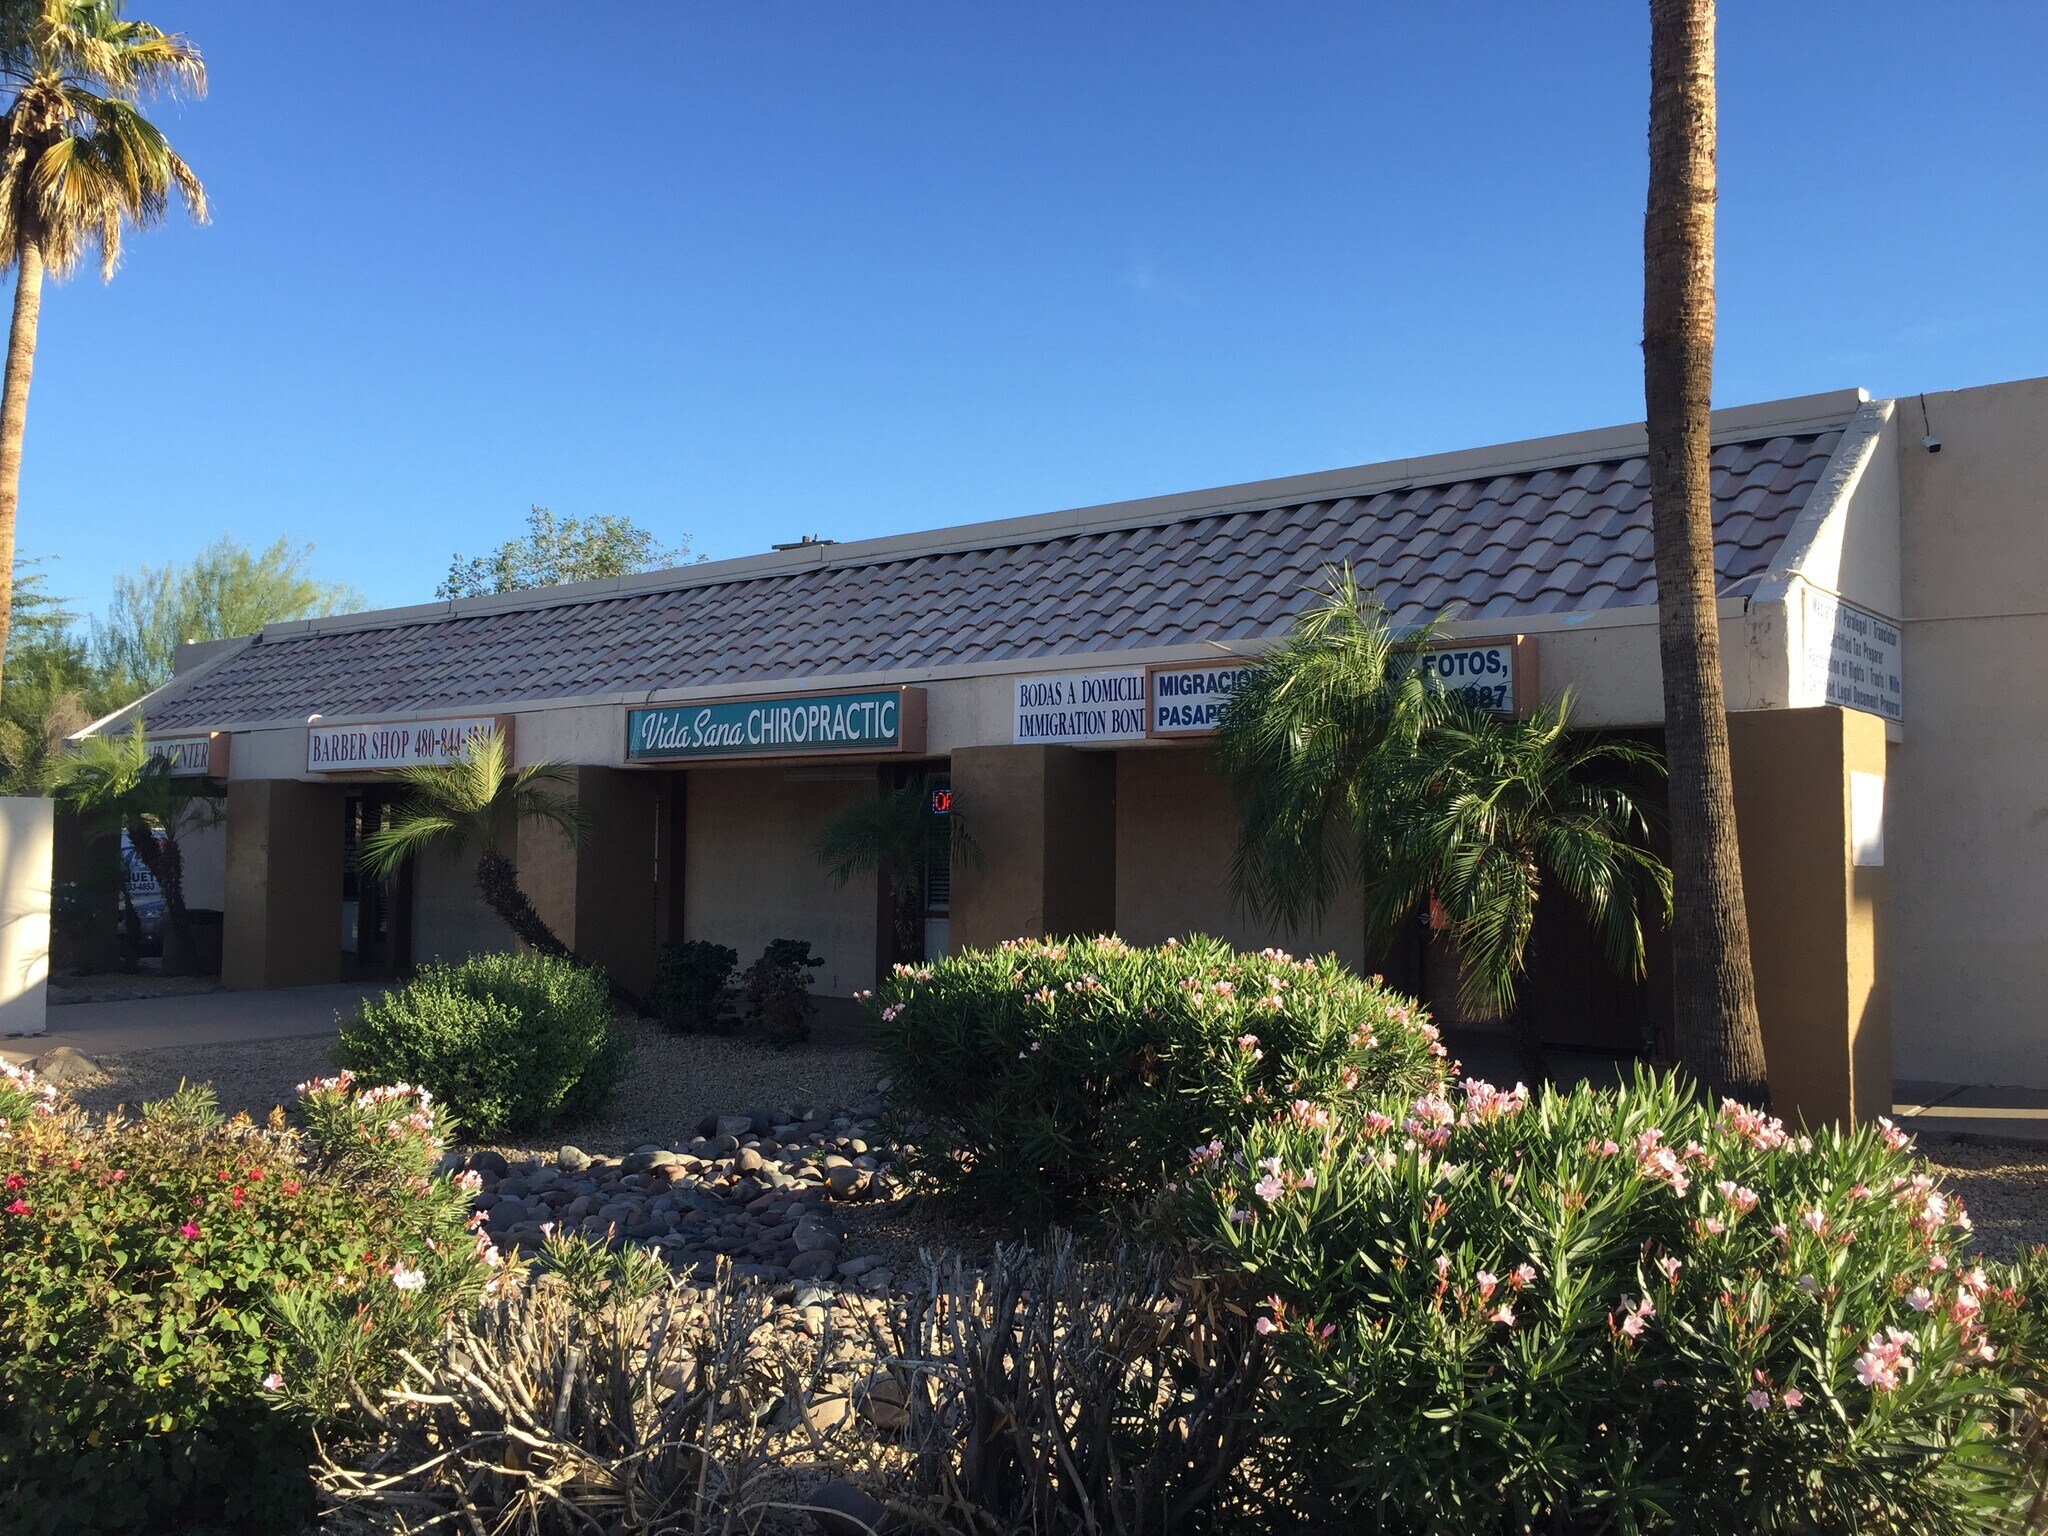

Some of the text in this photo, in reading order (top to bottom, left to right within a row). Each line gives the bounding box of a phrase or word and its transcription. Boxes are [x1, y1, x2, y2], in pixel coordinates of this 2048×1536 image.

[1842, 608, 1868, 637] Paralegal
[1852, 637, 1861, 657] Tax
[1020, 681, 1062, 707] BODAS
[1067, 681, 1077, 705] A
[1159, 670, 1254, 697] MIGRACIO
[641, 700, 896, 750] Vida Sana CHIROPRACTIC
[1019, 710, 1106, 737] IMMIGRATION
[167, 743, 209, 769] CENTER
[313, 732, 367, 762] BARBER
[371, 730, 410, 760] SHOP
